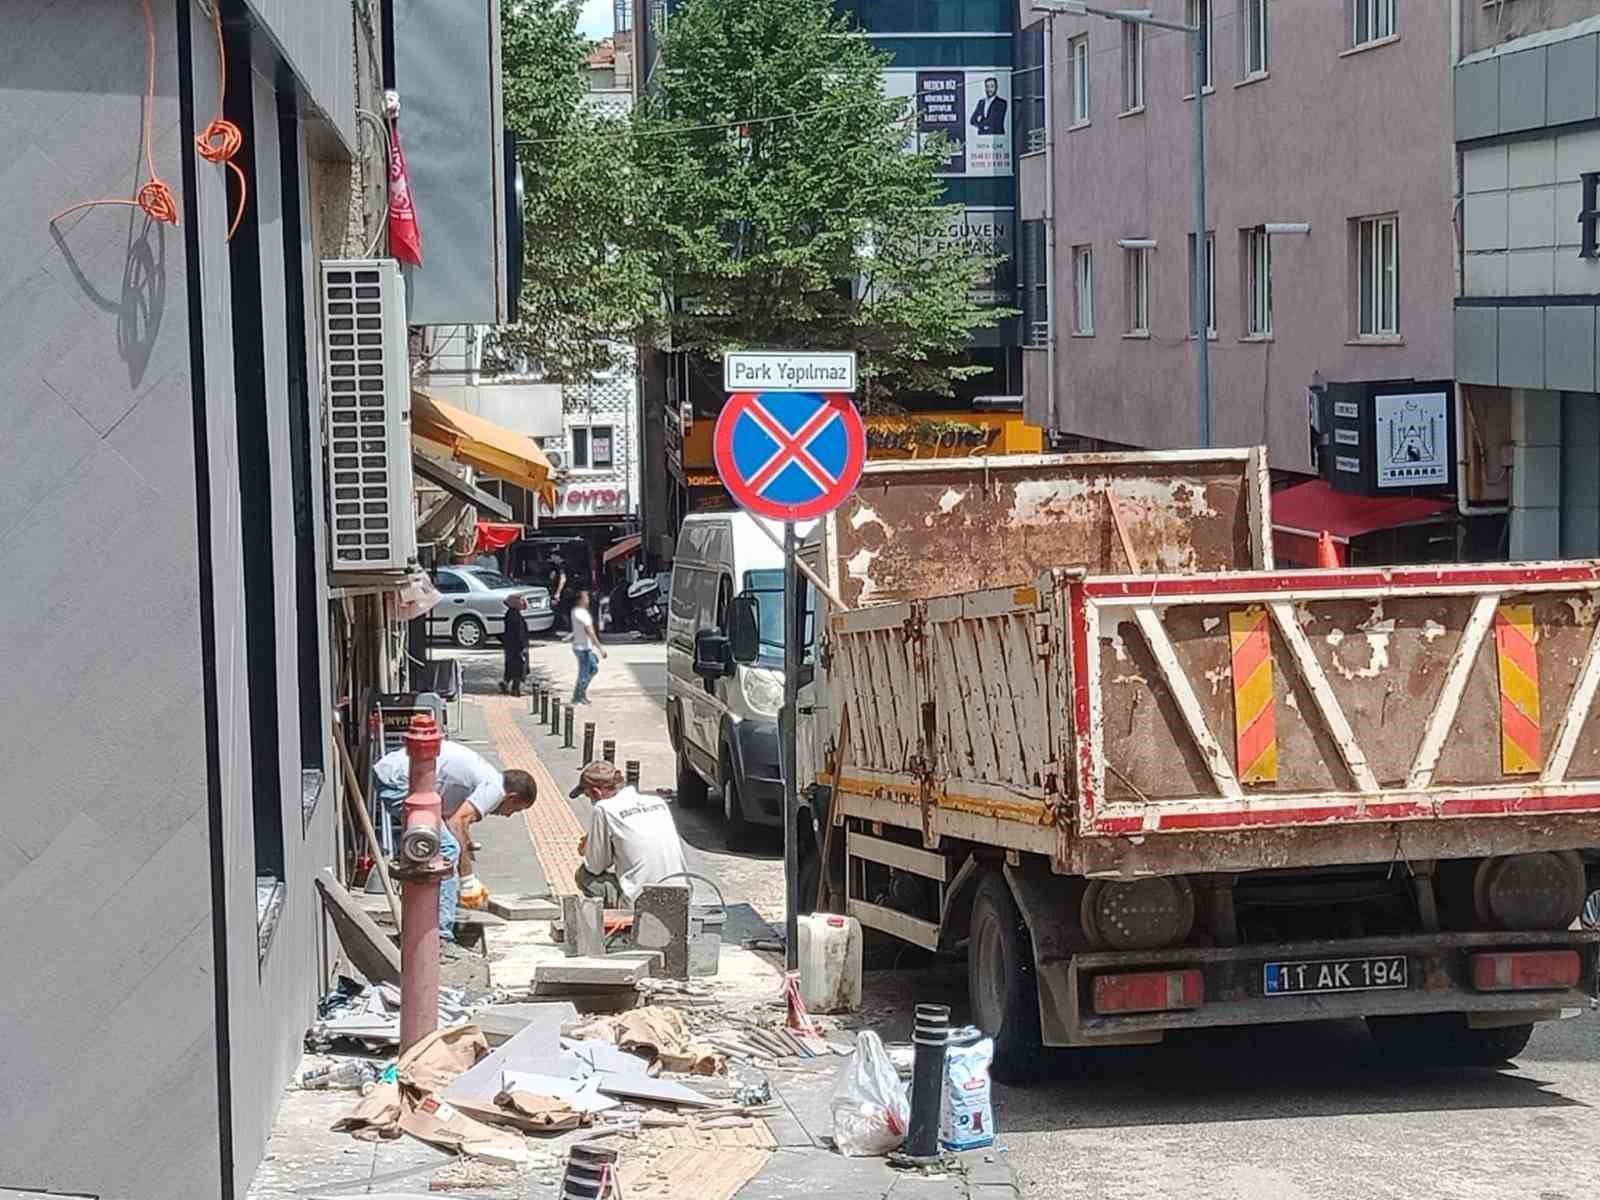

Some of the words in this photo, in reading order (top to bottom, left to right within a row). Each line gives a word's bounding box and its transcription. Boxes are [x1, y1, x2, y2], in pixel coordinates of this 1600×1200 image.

[736, 363, 772, 380] Park
[777, 363, 847, 384] Yapılmaz
[1280, 964, 1307, 990] 11
[1317, 963, 1350, 988] AK
[1362, 960, 1402, 985] 194
